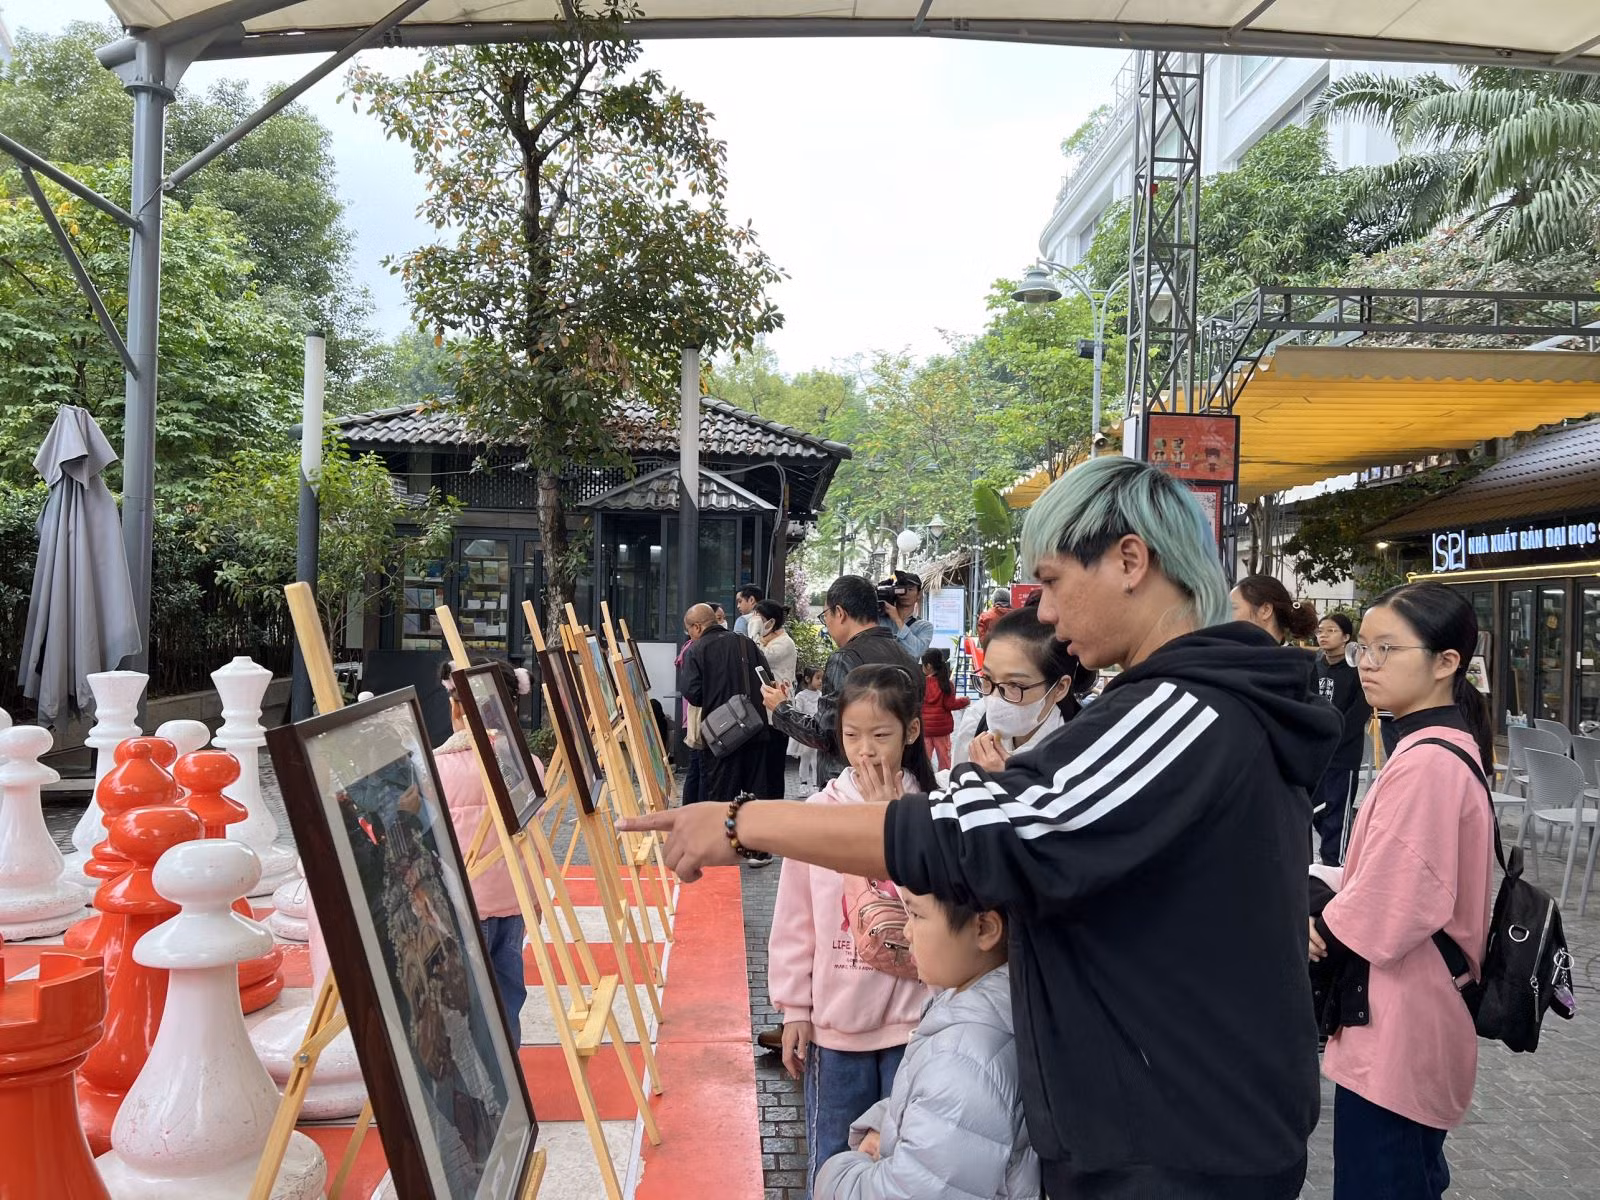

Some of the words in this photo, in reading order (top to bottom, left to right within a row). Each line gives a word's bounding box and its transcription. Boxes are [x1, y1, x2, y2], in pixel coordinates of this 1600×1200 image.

[1468, 532, 1489, 555] NHÀ
[1490, 526, 1518, 553] XUẤT
[1520, 525, 1544, 550] BẢN
[1545, 526, 1567, 551] ĐẠI
[1568, 522, 1596, 548] HỌC
[832, 940, 851, 949] LIFE
